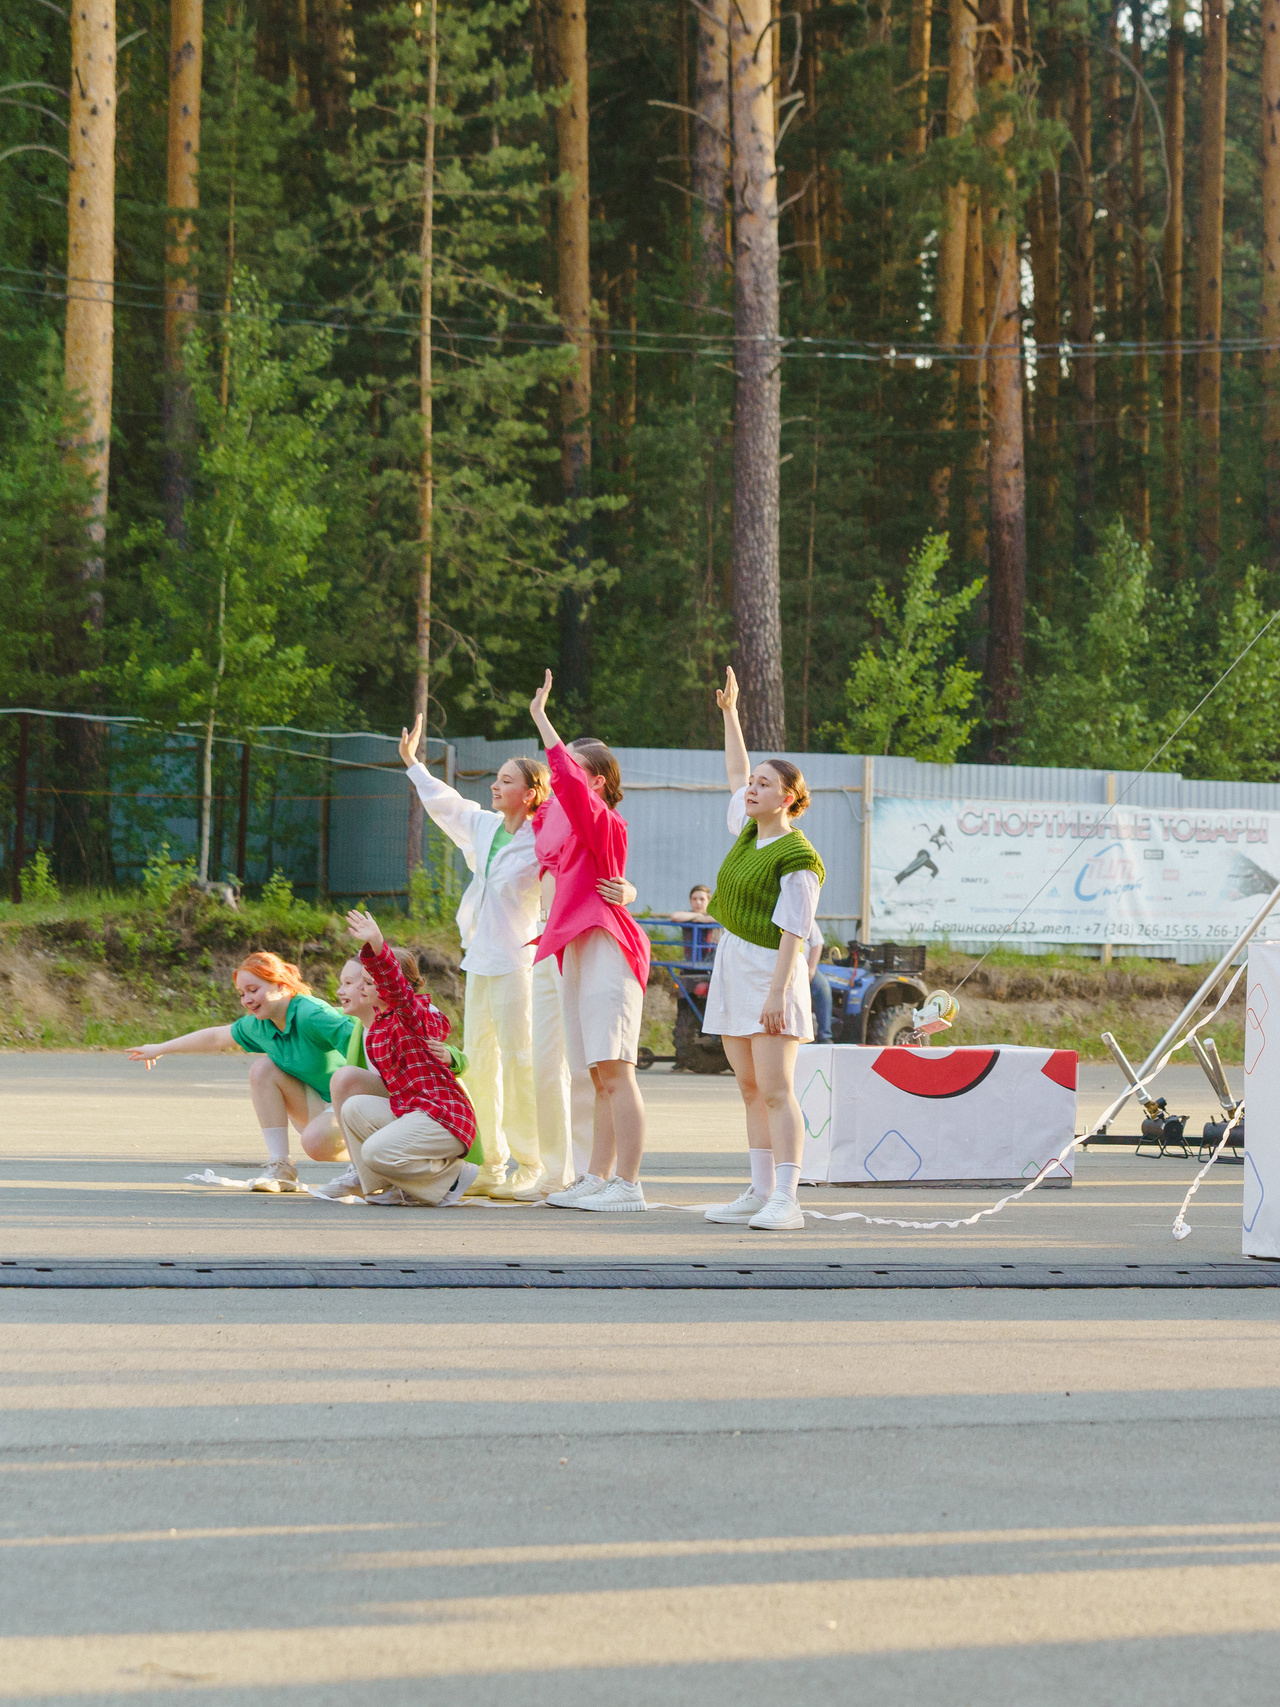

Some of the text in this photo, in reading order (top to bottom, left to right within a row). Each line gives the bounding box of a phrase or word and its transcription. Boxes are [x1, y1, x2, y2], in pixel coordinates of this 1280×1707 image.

[957, 807, 1268, 844] СПОРТИВНЫЕ ТОВАРЫ
[906, 922, 927, 935] ул.
[1085, 922, 1101, 935] +7
[1104, 921, 1134, 939] (343)
[1137, 923, 1202, 938] 266-15-55,
